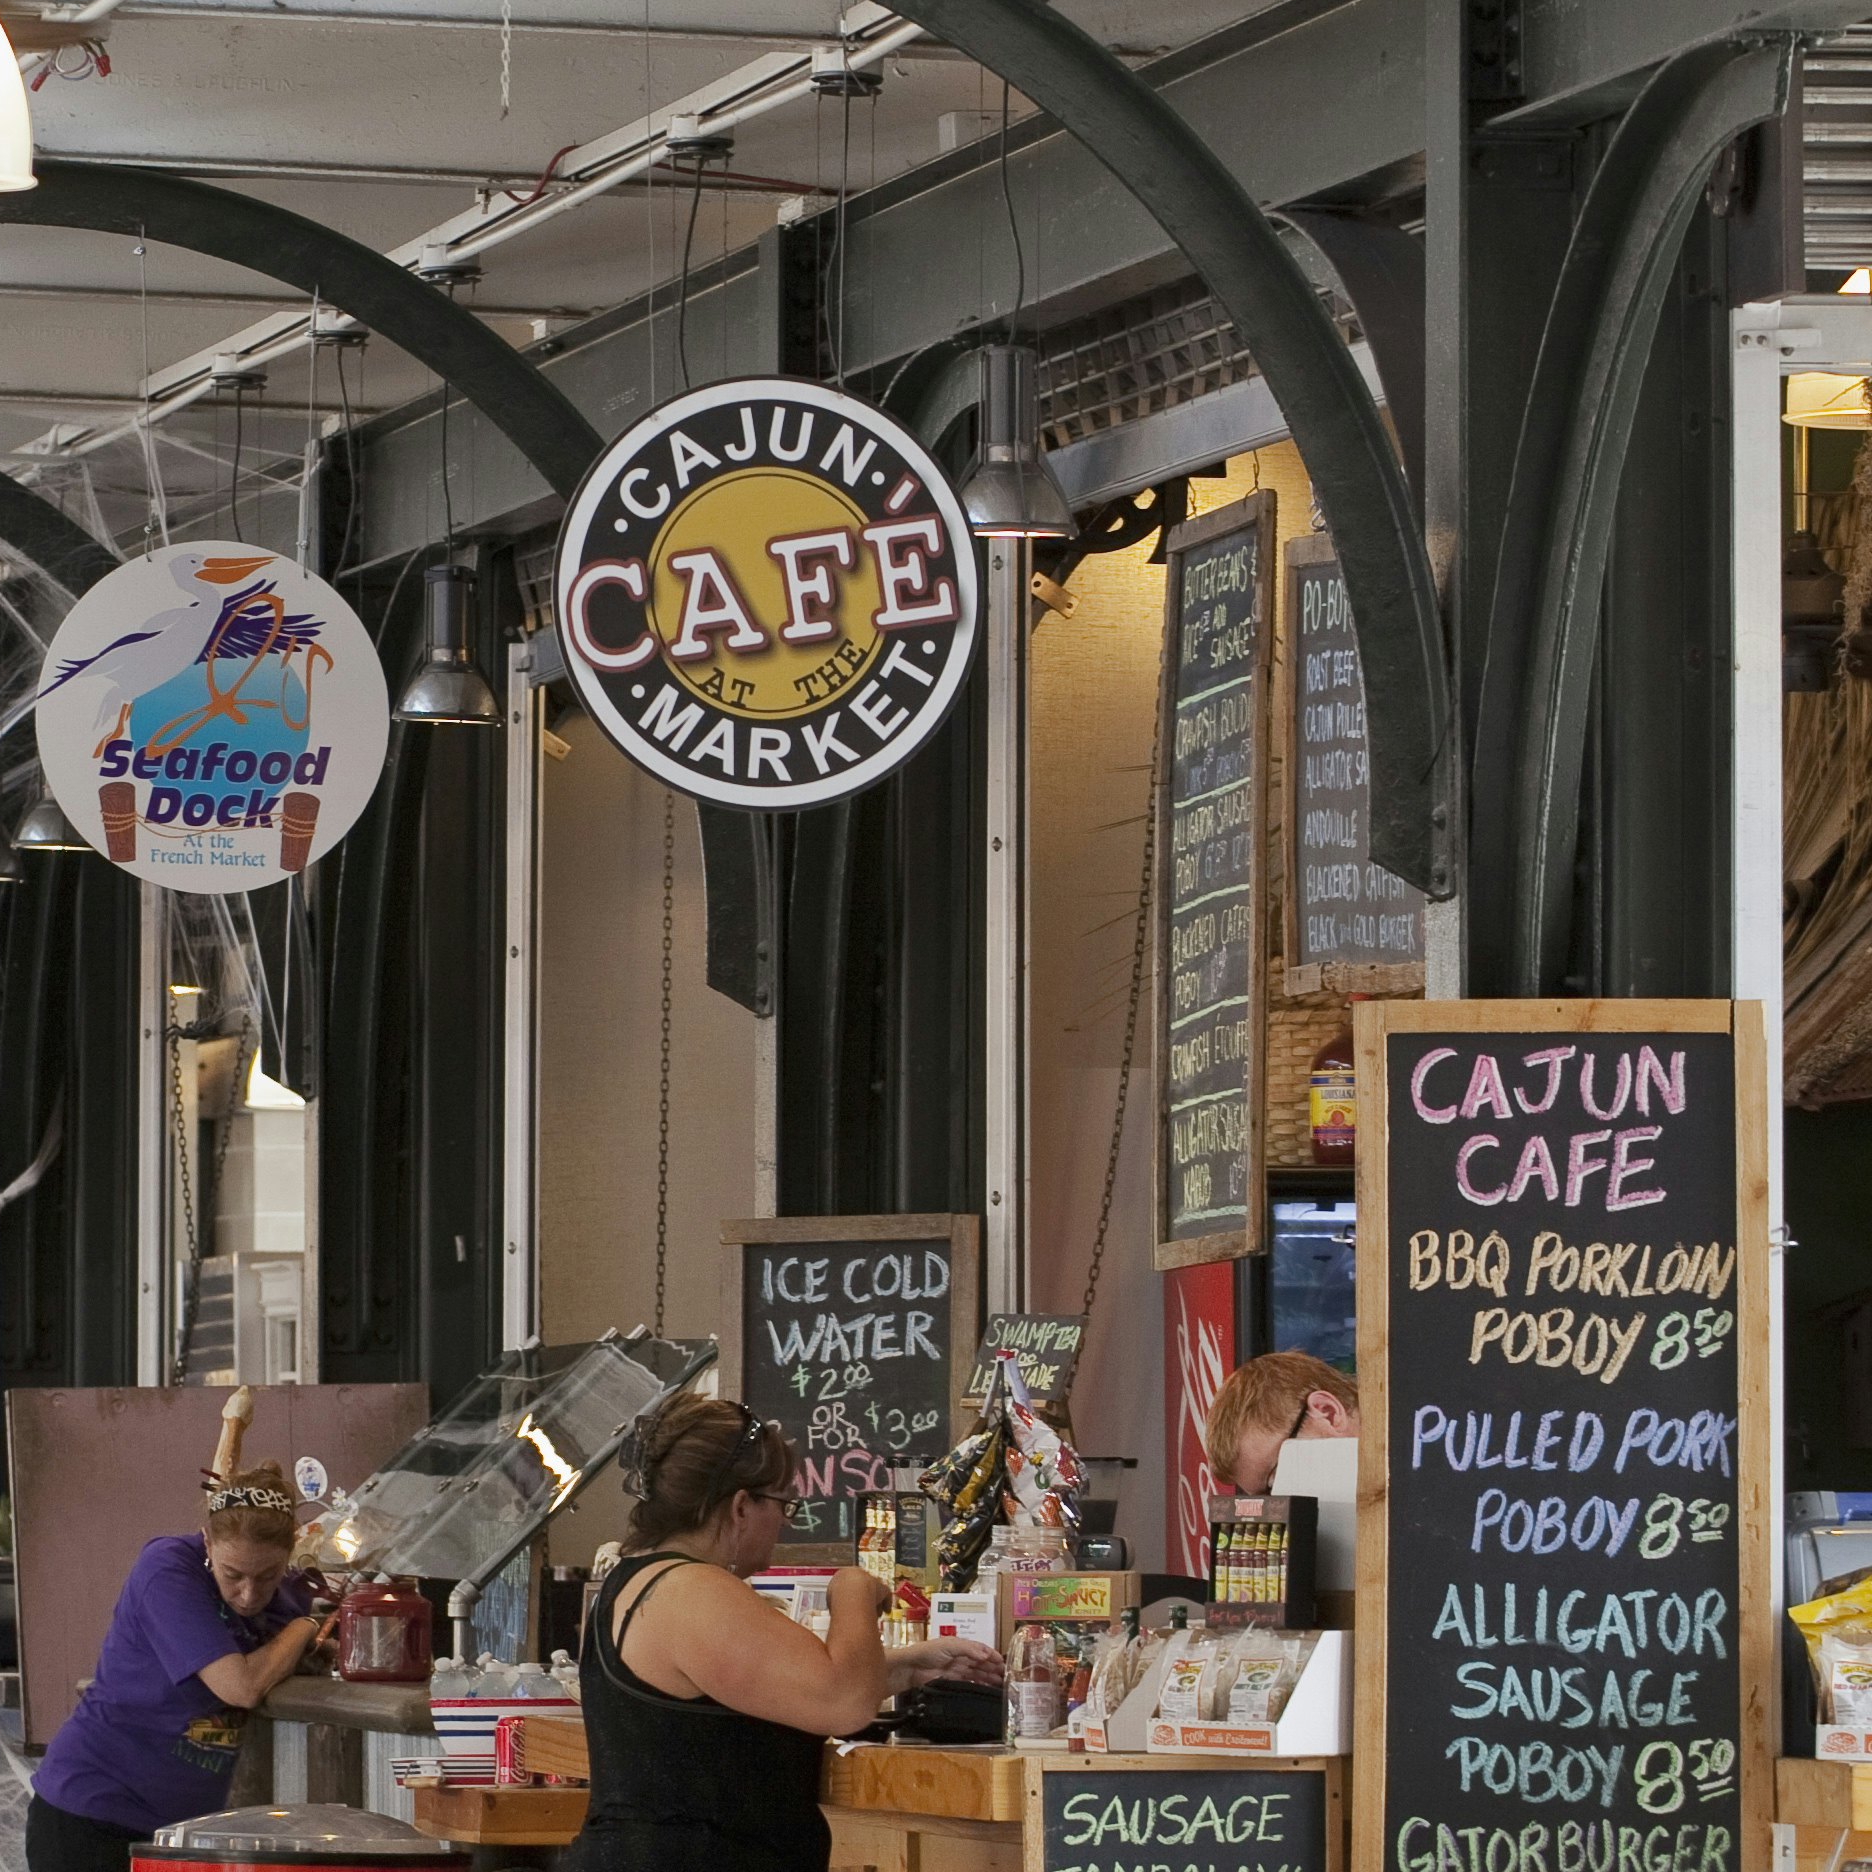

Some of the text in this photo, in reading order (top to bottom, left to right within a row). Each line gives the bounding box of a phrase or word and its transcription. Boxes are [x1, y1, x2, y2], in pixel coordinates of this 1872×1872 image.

[619, 406, 878, 520] CAJUN
[566, 482, 960, 673] CAFÉ
[699, 637, 869, 708] AT THE
[637, 641, 935, 782] MARKET
[98, 739, 333, 786] Seafood
[1304, 748, 1353, 798] ALLIGATOR
[143, 785, 282, 829] Dock
[1304, 808, 1358, 848] ANDOUILLE
[150, 848, 267, 868] French Market
[183, 834, 235, 849] At the
[1306, 862, 1360, 905] BLACKENED
[1307, 913, 1338, 953] BLACK
[1353, 913, 1377, 949] GOLD
[1378, 911, 1417, 955] BURGER
[1409, 1043, 1688, 1125] CAJUN
[1455, 1125, 1669, 1213] CAFE
[762, 1250, 950, 1305] ICE COLD
[1408, 1229, 1512, 1299] BBQ
[765, 1310, 942, 1367] WATER
[1468, 1306, 1648, 1385] POBOY
[807, 1424, 870, 1450] FOR
[812, 1401, 853, 1426] OR
[1411, 1404, 1737, 1479] PULLED PORK
[1470, 1488, 1640, 1560] POBOY
[1432, 1582, 1728, 1660] ALLIGATOR
[1450, 1660, 1700, 1730] SAUSAGE
[1445, 1734, 1626, 1809] POBOY
[1062, 1792, 1292, 1847] SAUSAGE
